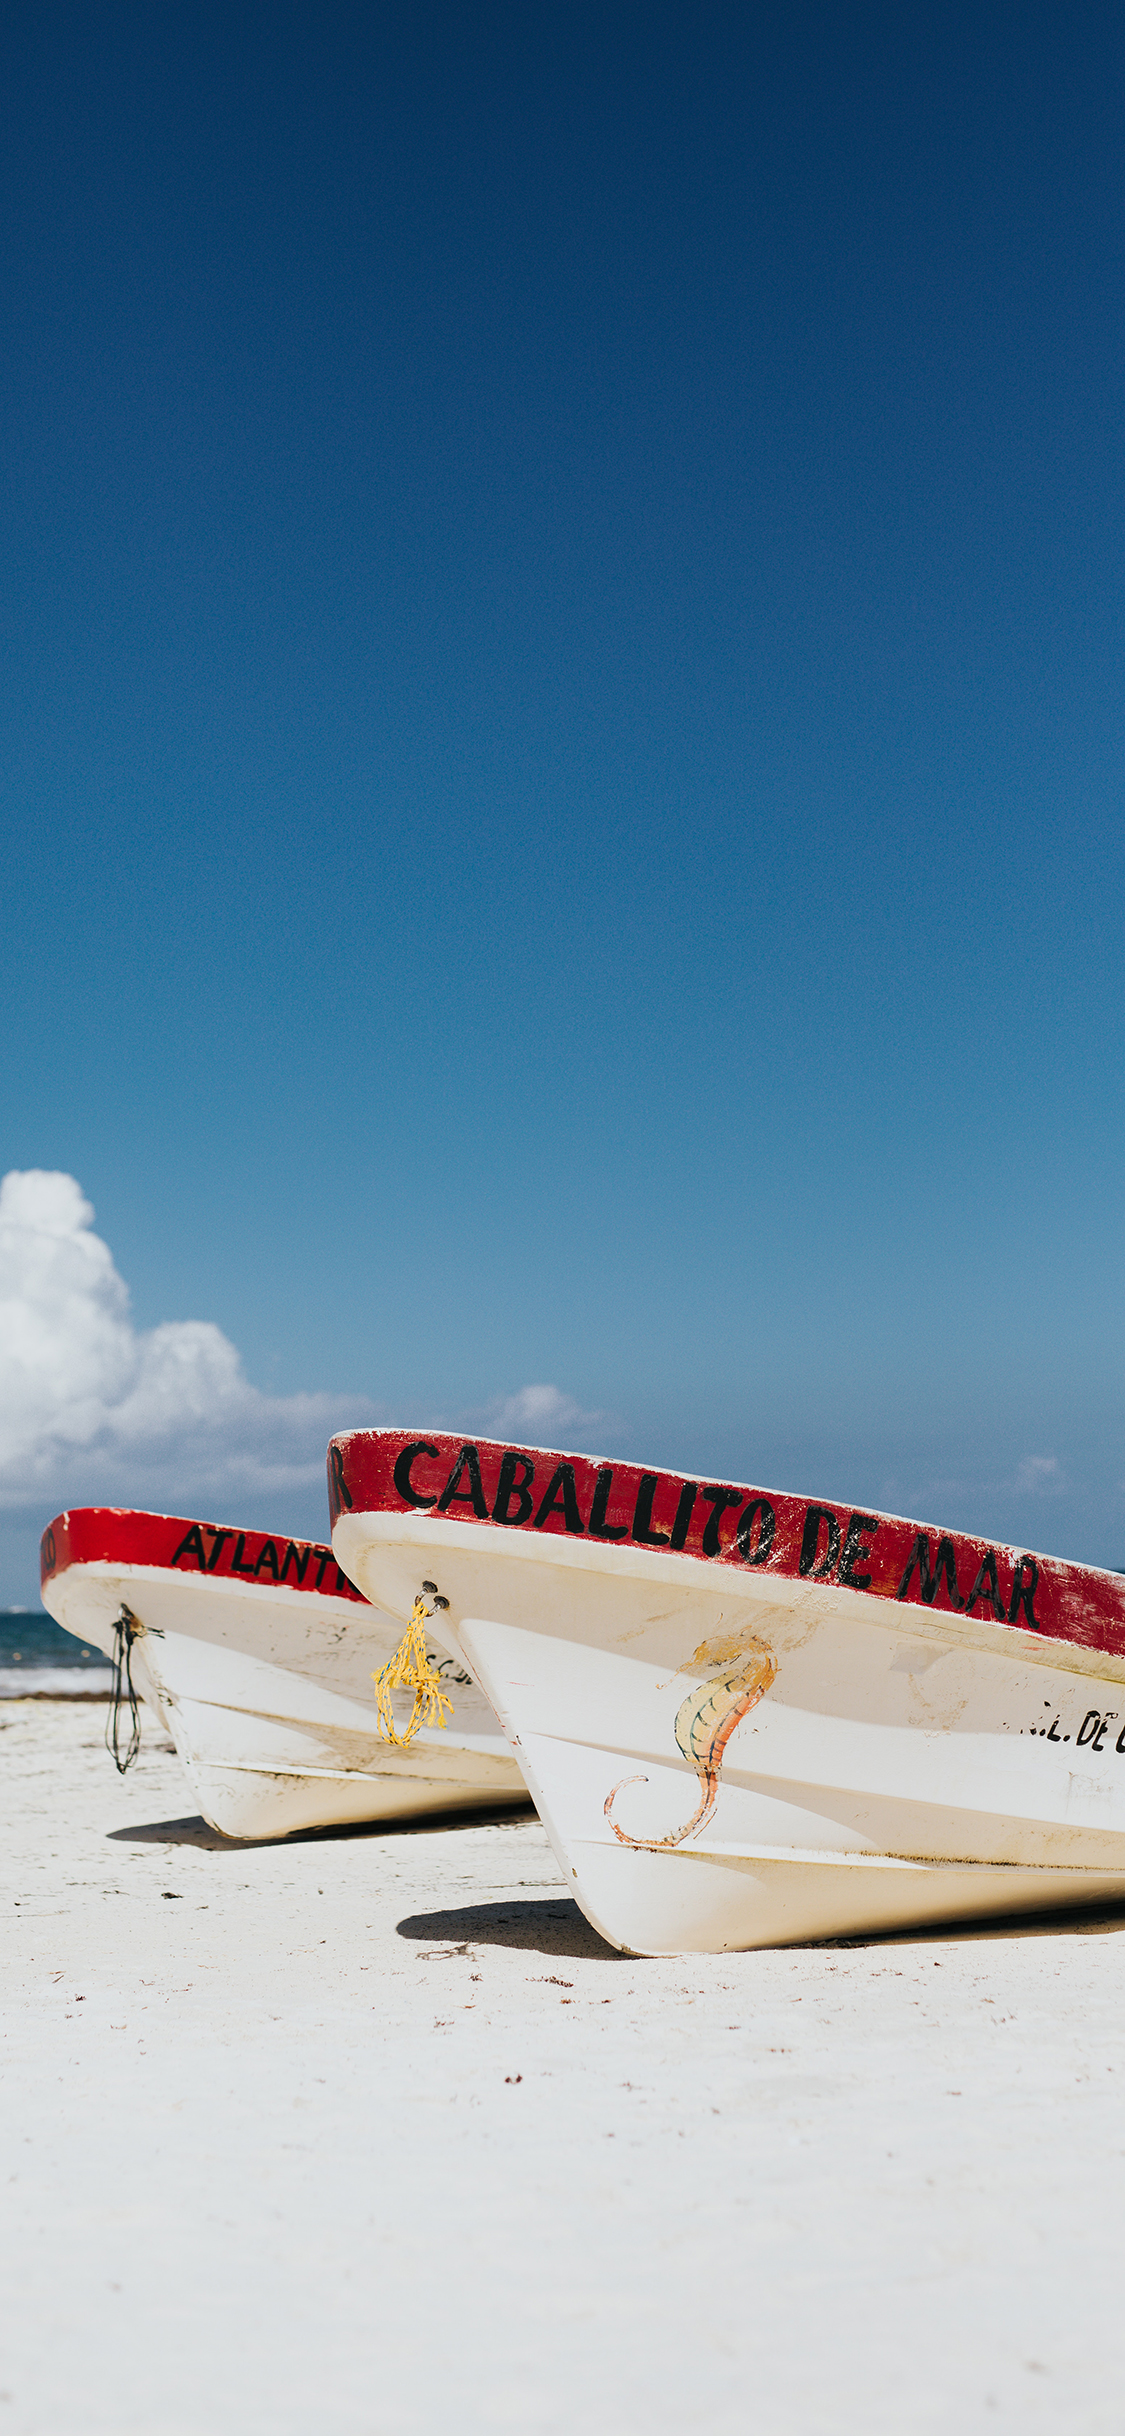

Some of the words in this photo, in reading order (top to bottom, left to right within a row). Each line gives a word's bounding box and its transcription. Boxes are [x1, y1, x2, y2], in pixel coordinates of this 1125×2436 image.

[171, 1525, 361, 1594] ATLANTI
[394, 1441, 776, 1565] CABALLITO
[799, 1505, 878, 1589] DE
[896, 1533, 1040, 1630] MAR
[1076, 1710, 1118, 1751] DE
